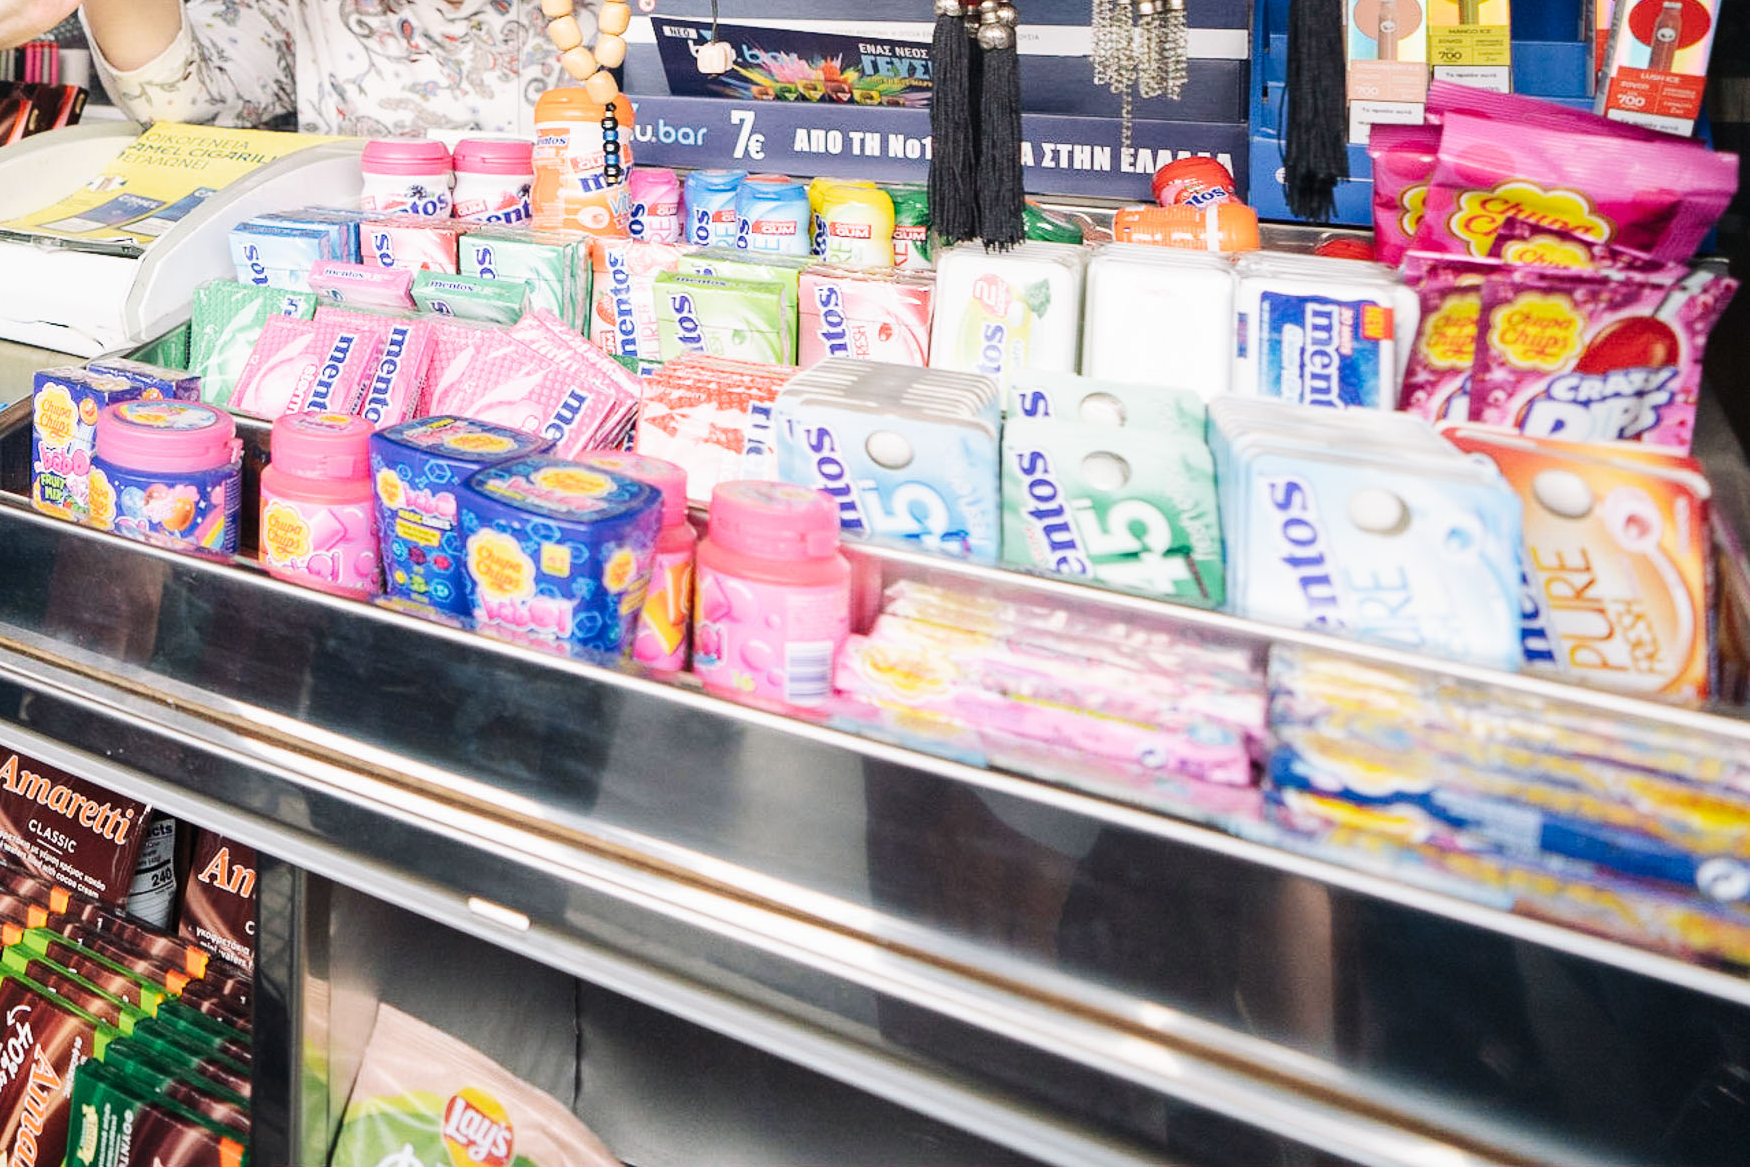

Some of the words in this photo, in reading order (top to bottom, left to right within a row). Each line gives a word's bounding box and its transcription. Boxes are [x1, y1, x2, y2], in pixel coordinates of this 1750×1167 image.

[669, 26, 691, 38] ΝΕΟ
[858, 43, 892, 55] ΕΝΑΣ
[895, 46, 929, 59] ΝΕΟΣ
[1438, 51, 1462, 60] 700
[1617, 94, 1645, 108] 700
[146, 132, 250, 150] ΟΙΚΟΓΕΝΕΙΑ
[730, 109, 766, 160] 7€
[793, 129, 843, 154] ΑΠΟ
[849, 131, 881, 156] ΤΗ
[1041, 142, 1111, 171] ΣΤΗΝ
[761, 223, 796, 234] GUM
[836, 226, 871, 237] GUM
[893, 230, 926, 240] GUM
[325, 269, 365, 279] mentos
[429, 280, 474, 292] mentos
[1506, 309, 1575, 330] Chupa
[1500, 327, 1569, 349] Chups
[307, 335, 355, 412] ment
[364, 327, 410, 424] mento
[1548, 367, 1679, 402] CRAZY
[41, 399, 73, 419] Chupa
[40, 414, 71, 435] Chups
[1016, 451, 1087, 575] entos
[268, 513, 303, 536] Chupa
[267, 528, 301, 552] Chups
[1531, 547, 1629, 671] PURE
[28, 819, 78, 854] CLASSIC
[151, 870, 172, 888] 240
[0, 1021, 34, 1080] 40%
[443, 1096, 513, 1163] Lay's
